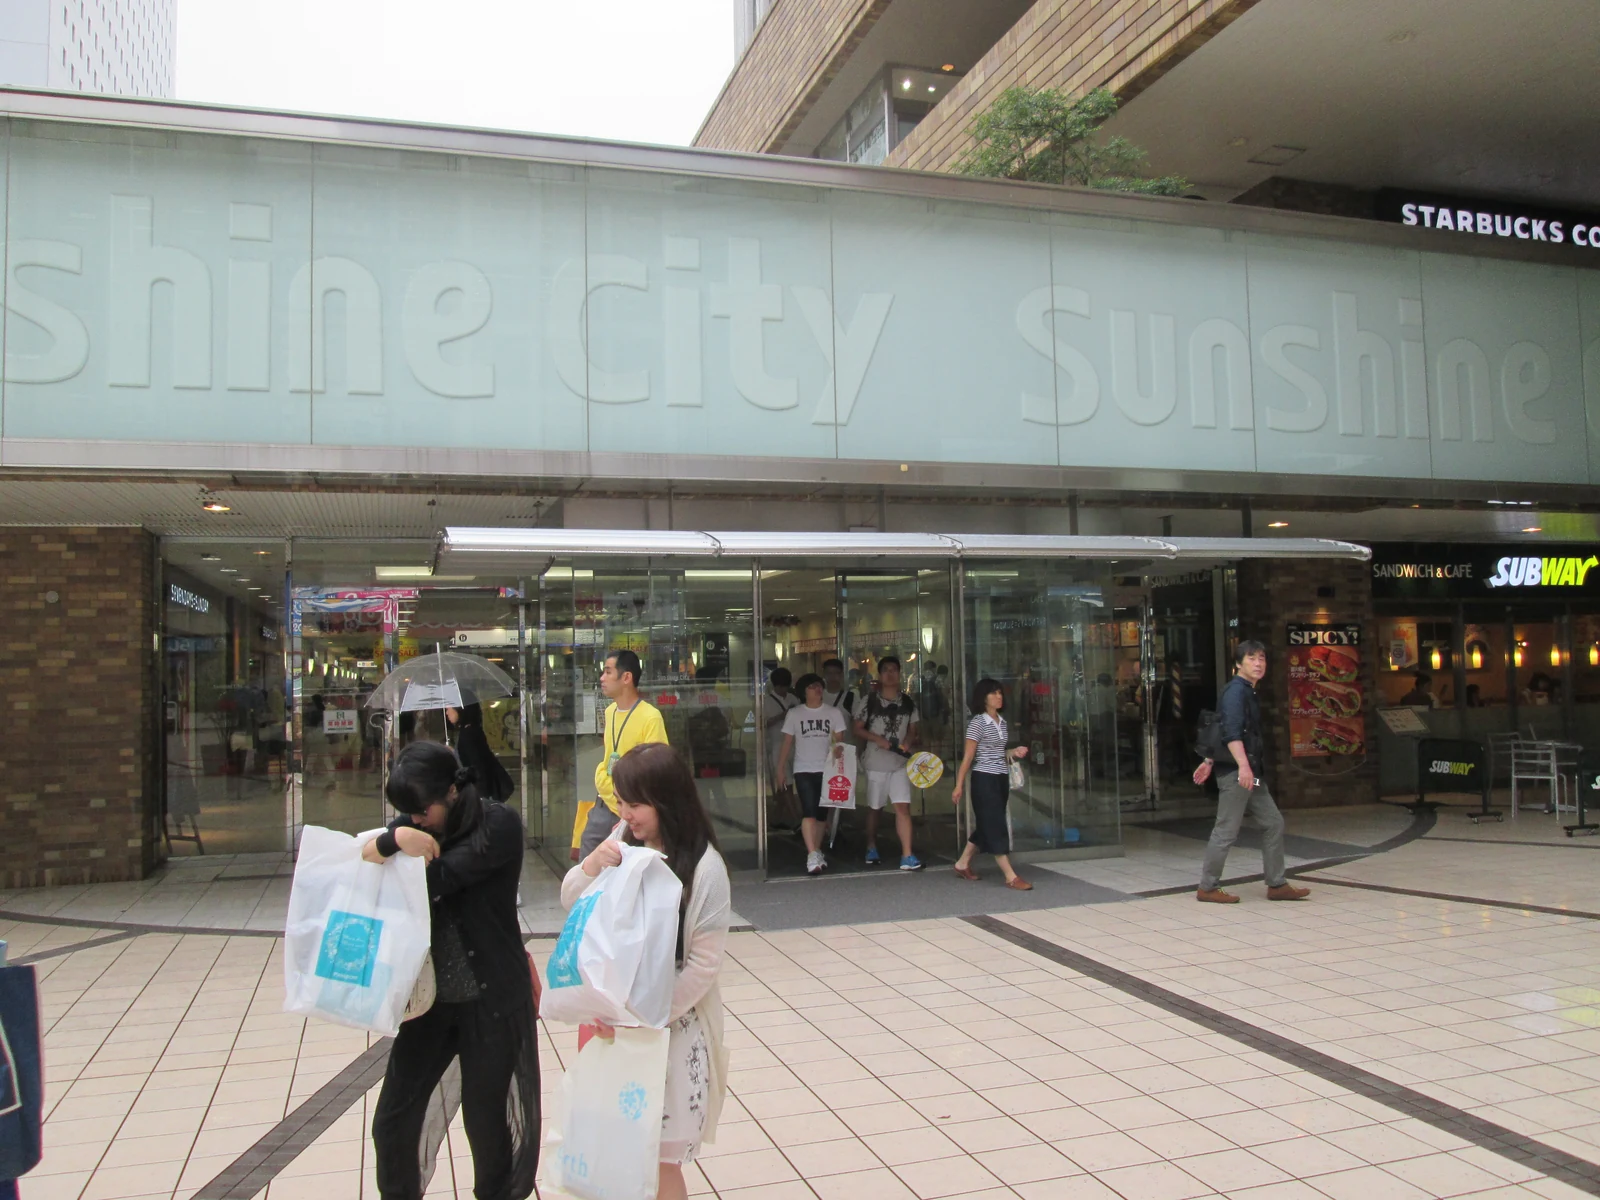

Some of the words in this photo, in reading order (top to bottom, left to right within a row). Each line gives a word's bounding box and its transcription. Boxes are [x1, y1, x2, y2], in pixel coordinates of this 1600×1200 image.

[1401, 203, 1564, 244] STARBUCKS
[549, 235, 895, 427] City
[1016, 284, 1558, 446] Sunshine
[1373, 563, 1434, 579] SANDWICH
[1435, 566, 1444, 578] &
[1488, 555, 1599, 588] SUBWAY
[1290, 630, 1358, 645] SPICY!
[1429, 760, 1475, 776] SUBWAY
